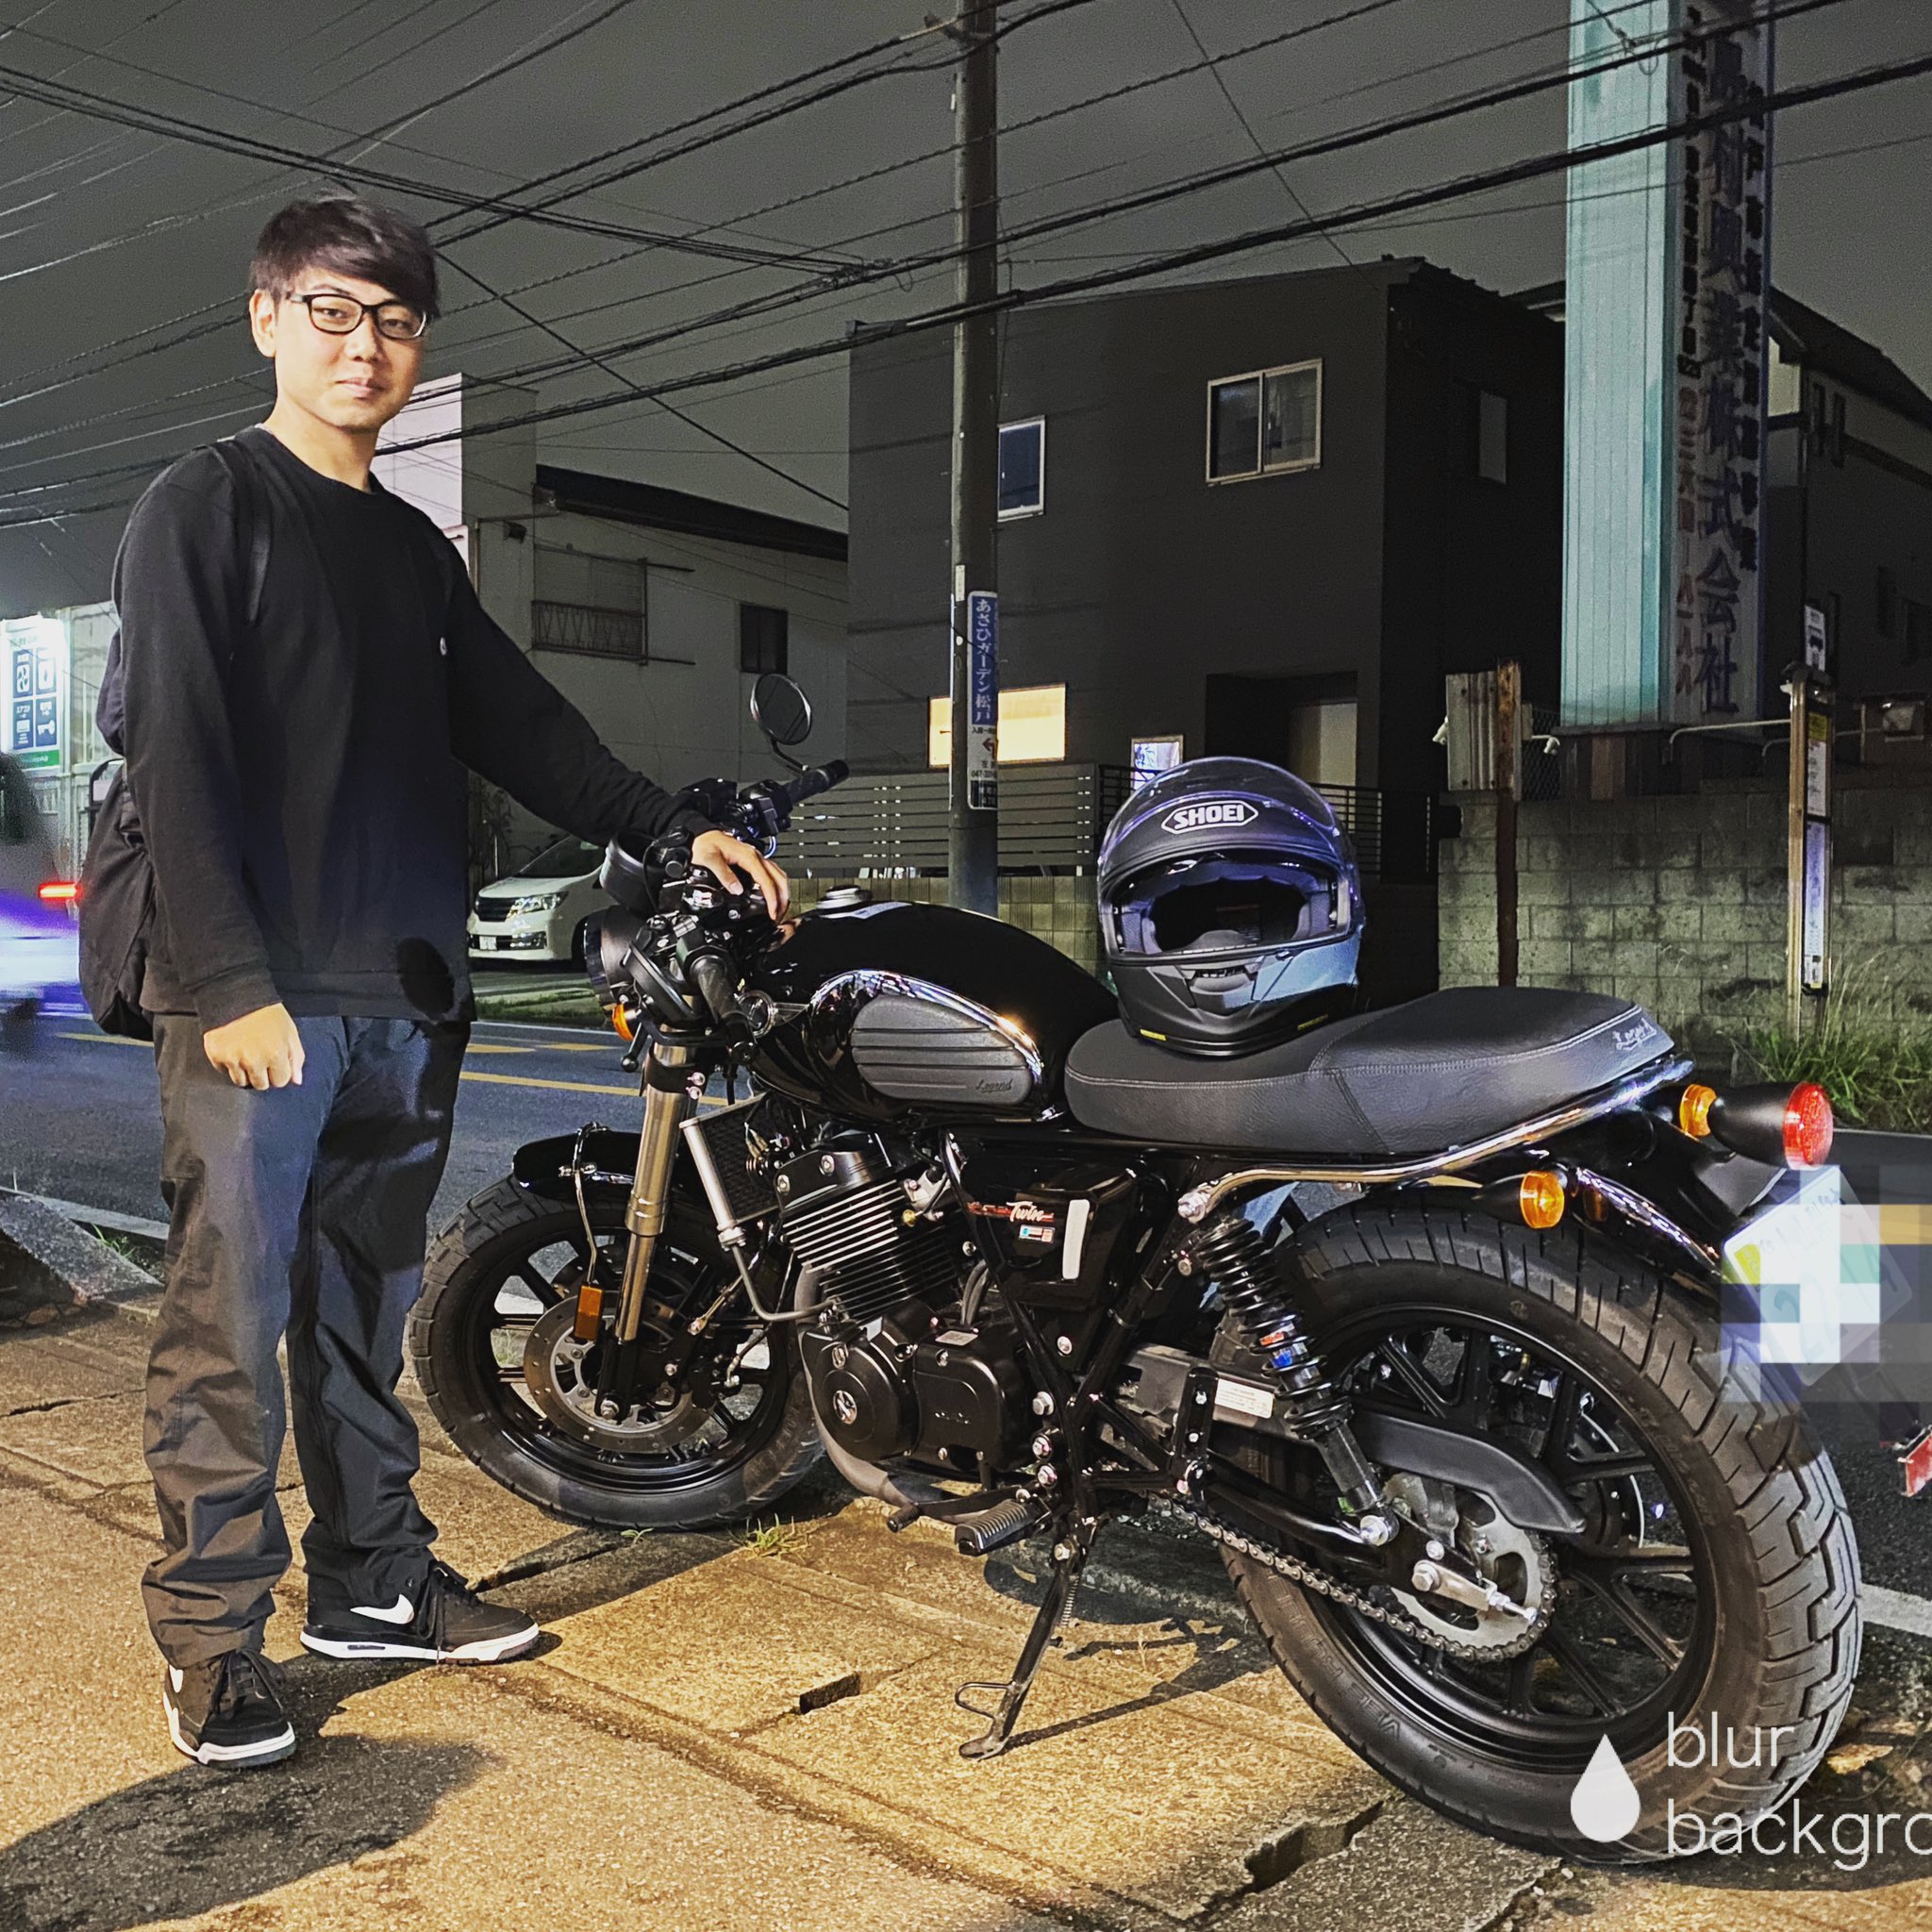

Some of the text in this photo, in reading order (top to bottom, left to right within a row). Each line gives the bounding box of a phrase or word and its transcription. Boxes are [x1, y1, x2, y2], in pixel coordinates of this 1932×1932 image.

[974, 598, 993, 723] あさひガーデン松戸
[1173, 802, 1244, 830] SHOEI
[974, 1077, 1013, 1094] Legend
[1006, 1200, 1051, 1223] Twin
